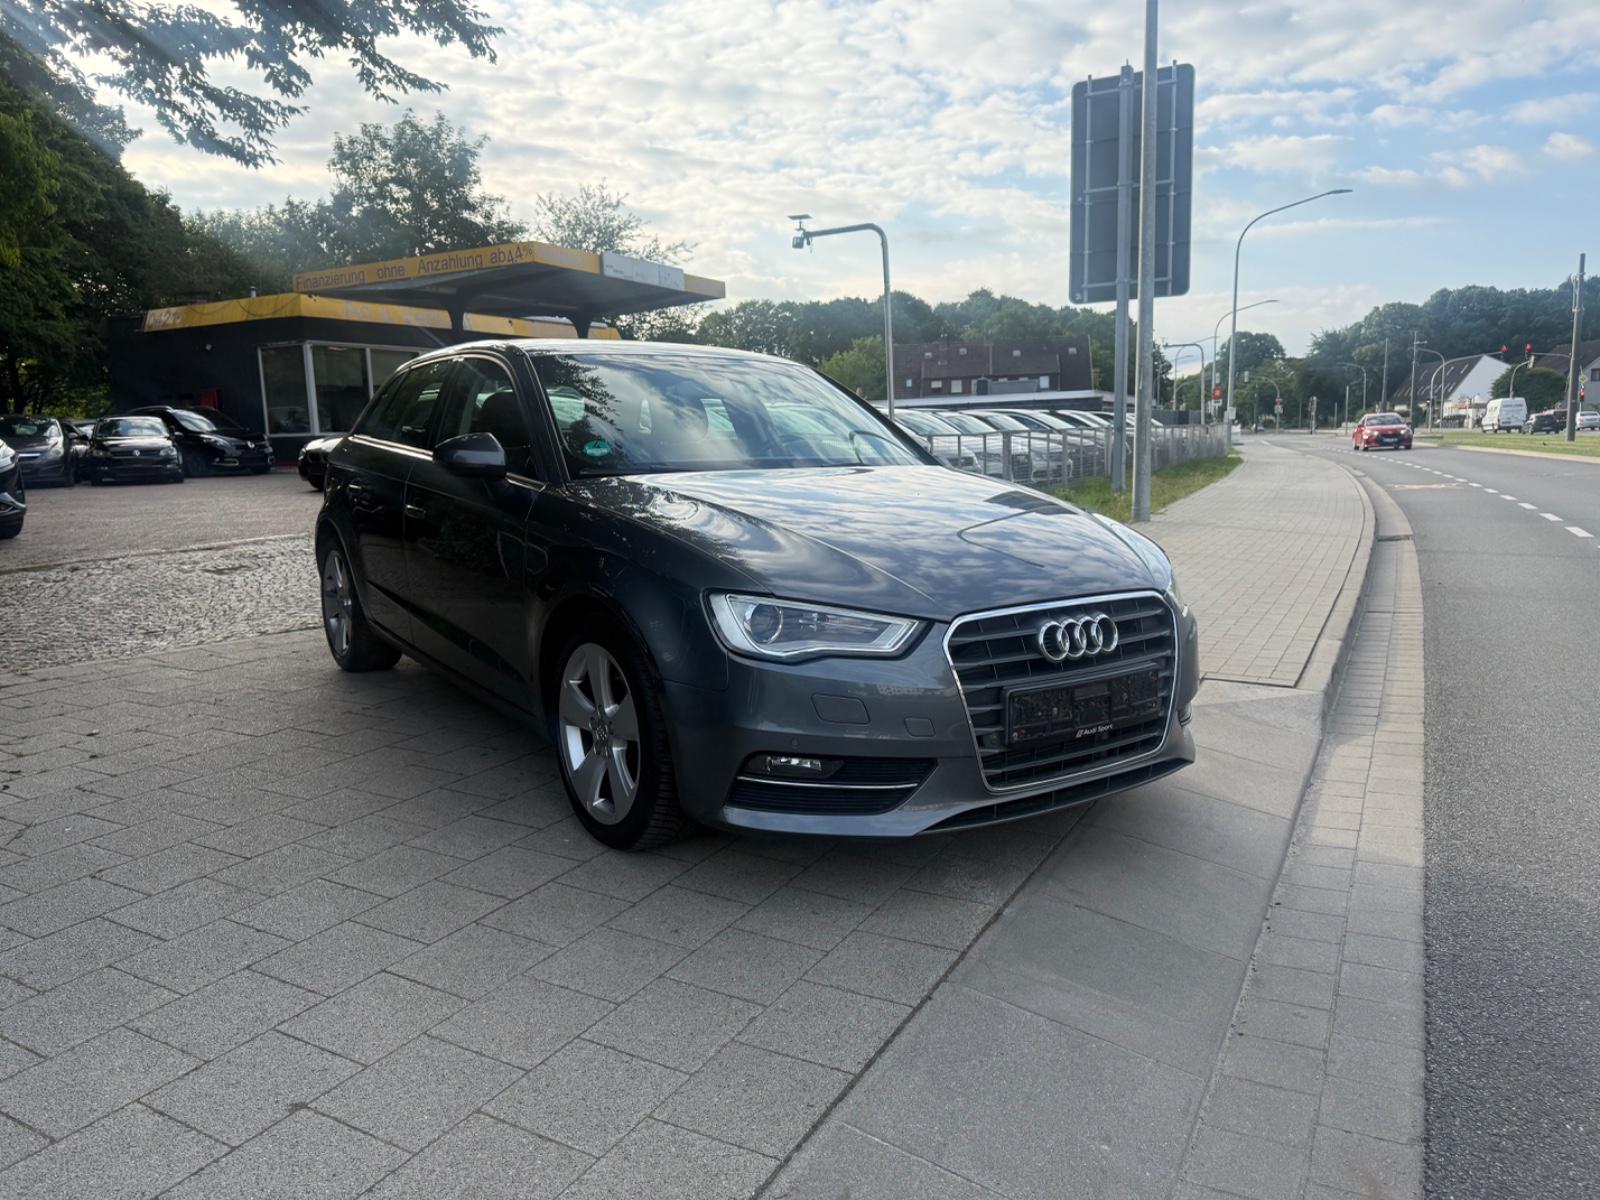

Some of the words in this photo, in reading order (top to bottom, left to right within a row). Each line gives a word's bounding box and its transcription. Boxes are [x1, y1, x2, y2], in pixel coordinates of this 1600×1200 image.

[296, 272, 365, 291] Finanzierung
[377, 265, 405, 280] ohne
[417, 254, 483, 274] Anzahlung
